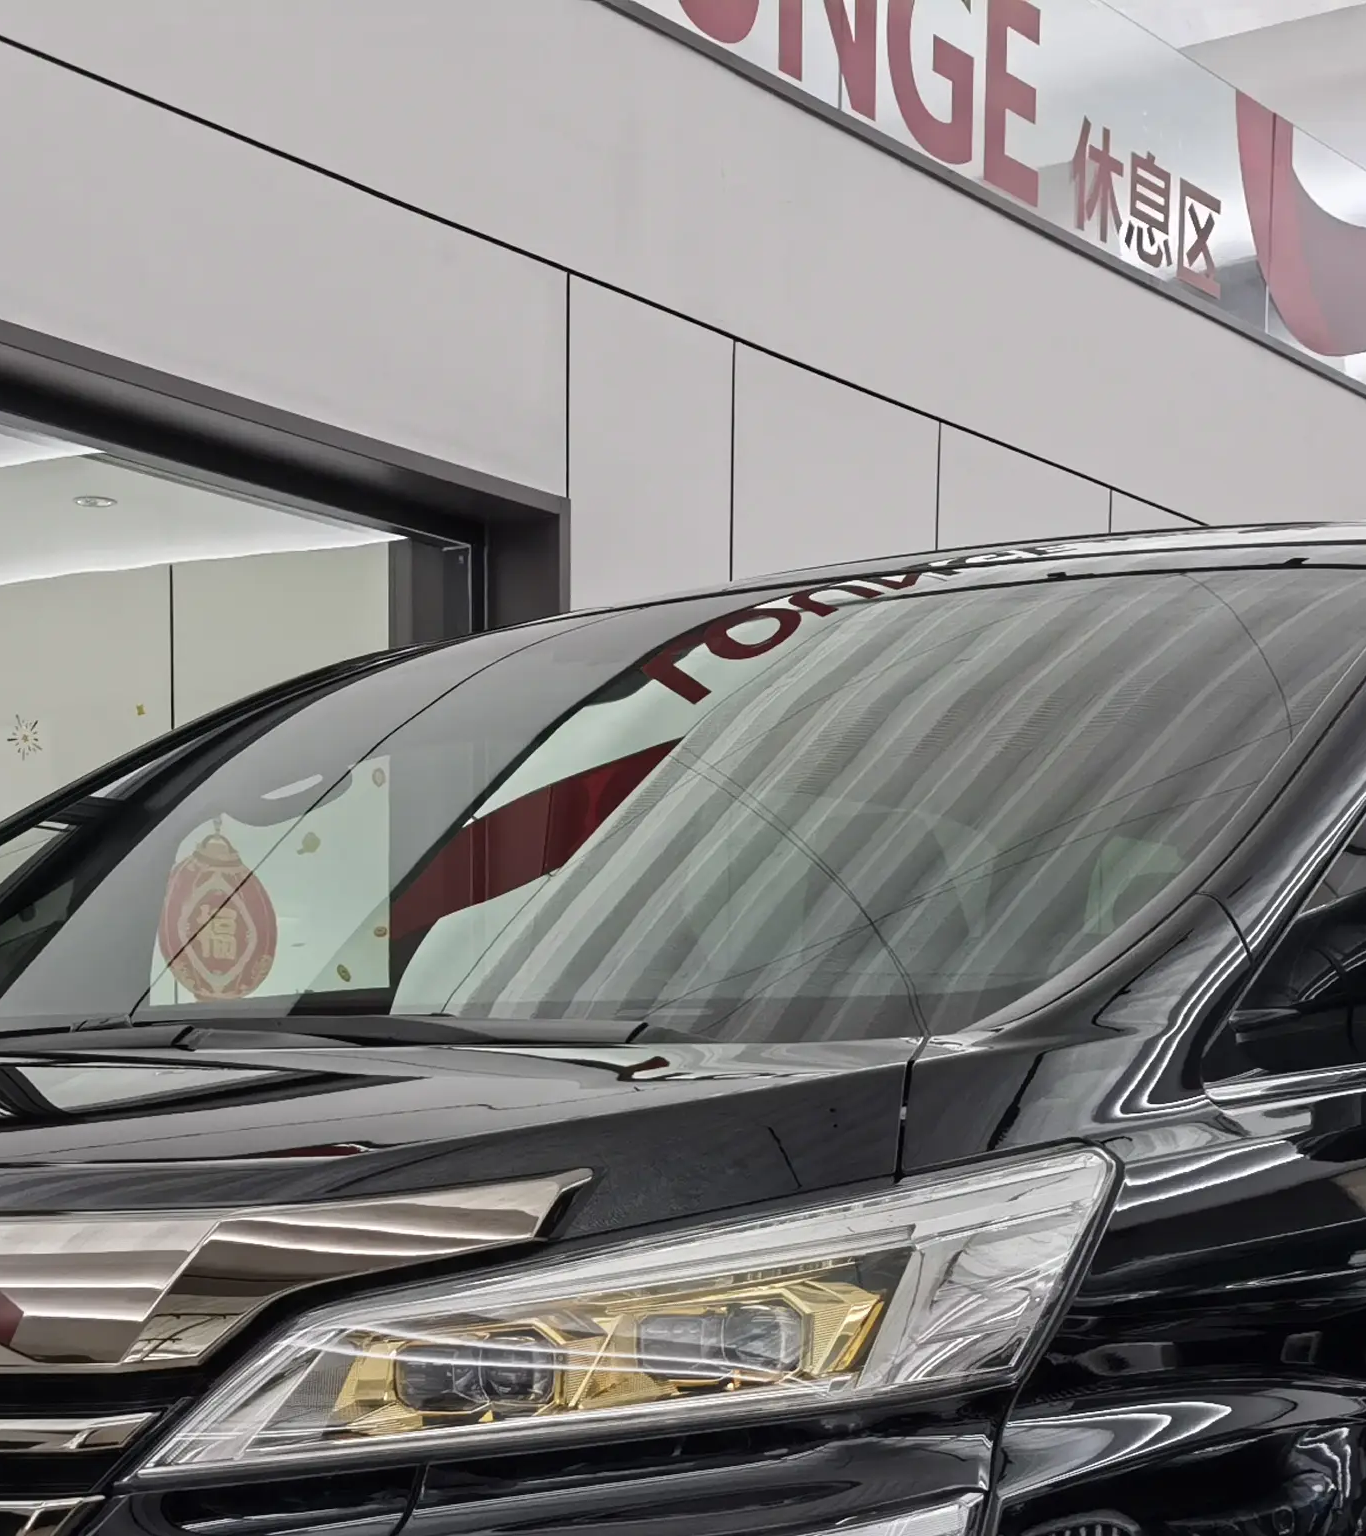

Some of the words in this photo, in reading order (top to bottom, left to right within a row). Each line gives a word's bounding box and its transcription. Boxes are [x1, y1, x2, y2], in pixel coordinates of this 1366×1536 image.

[678, 0, 1041, 208] NGE
[1072, 115, 1221, 300] 休息区
[195, 903, 238, 961] 福
